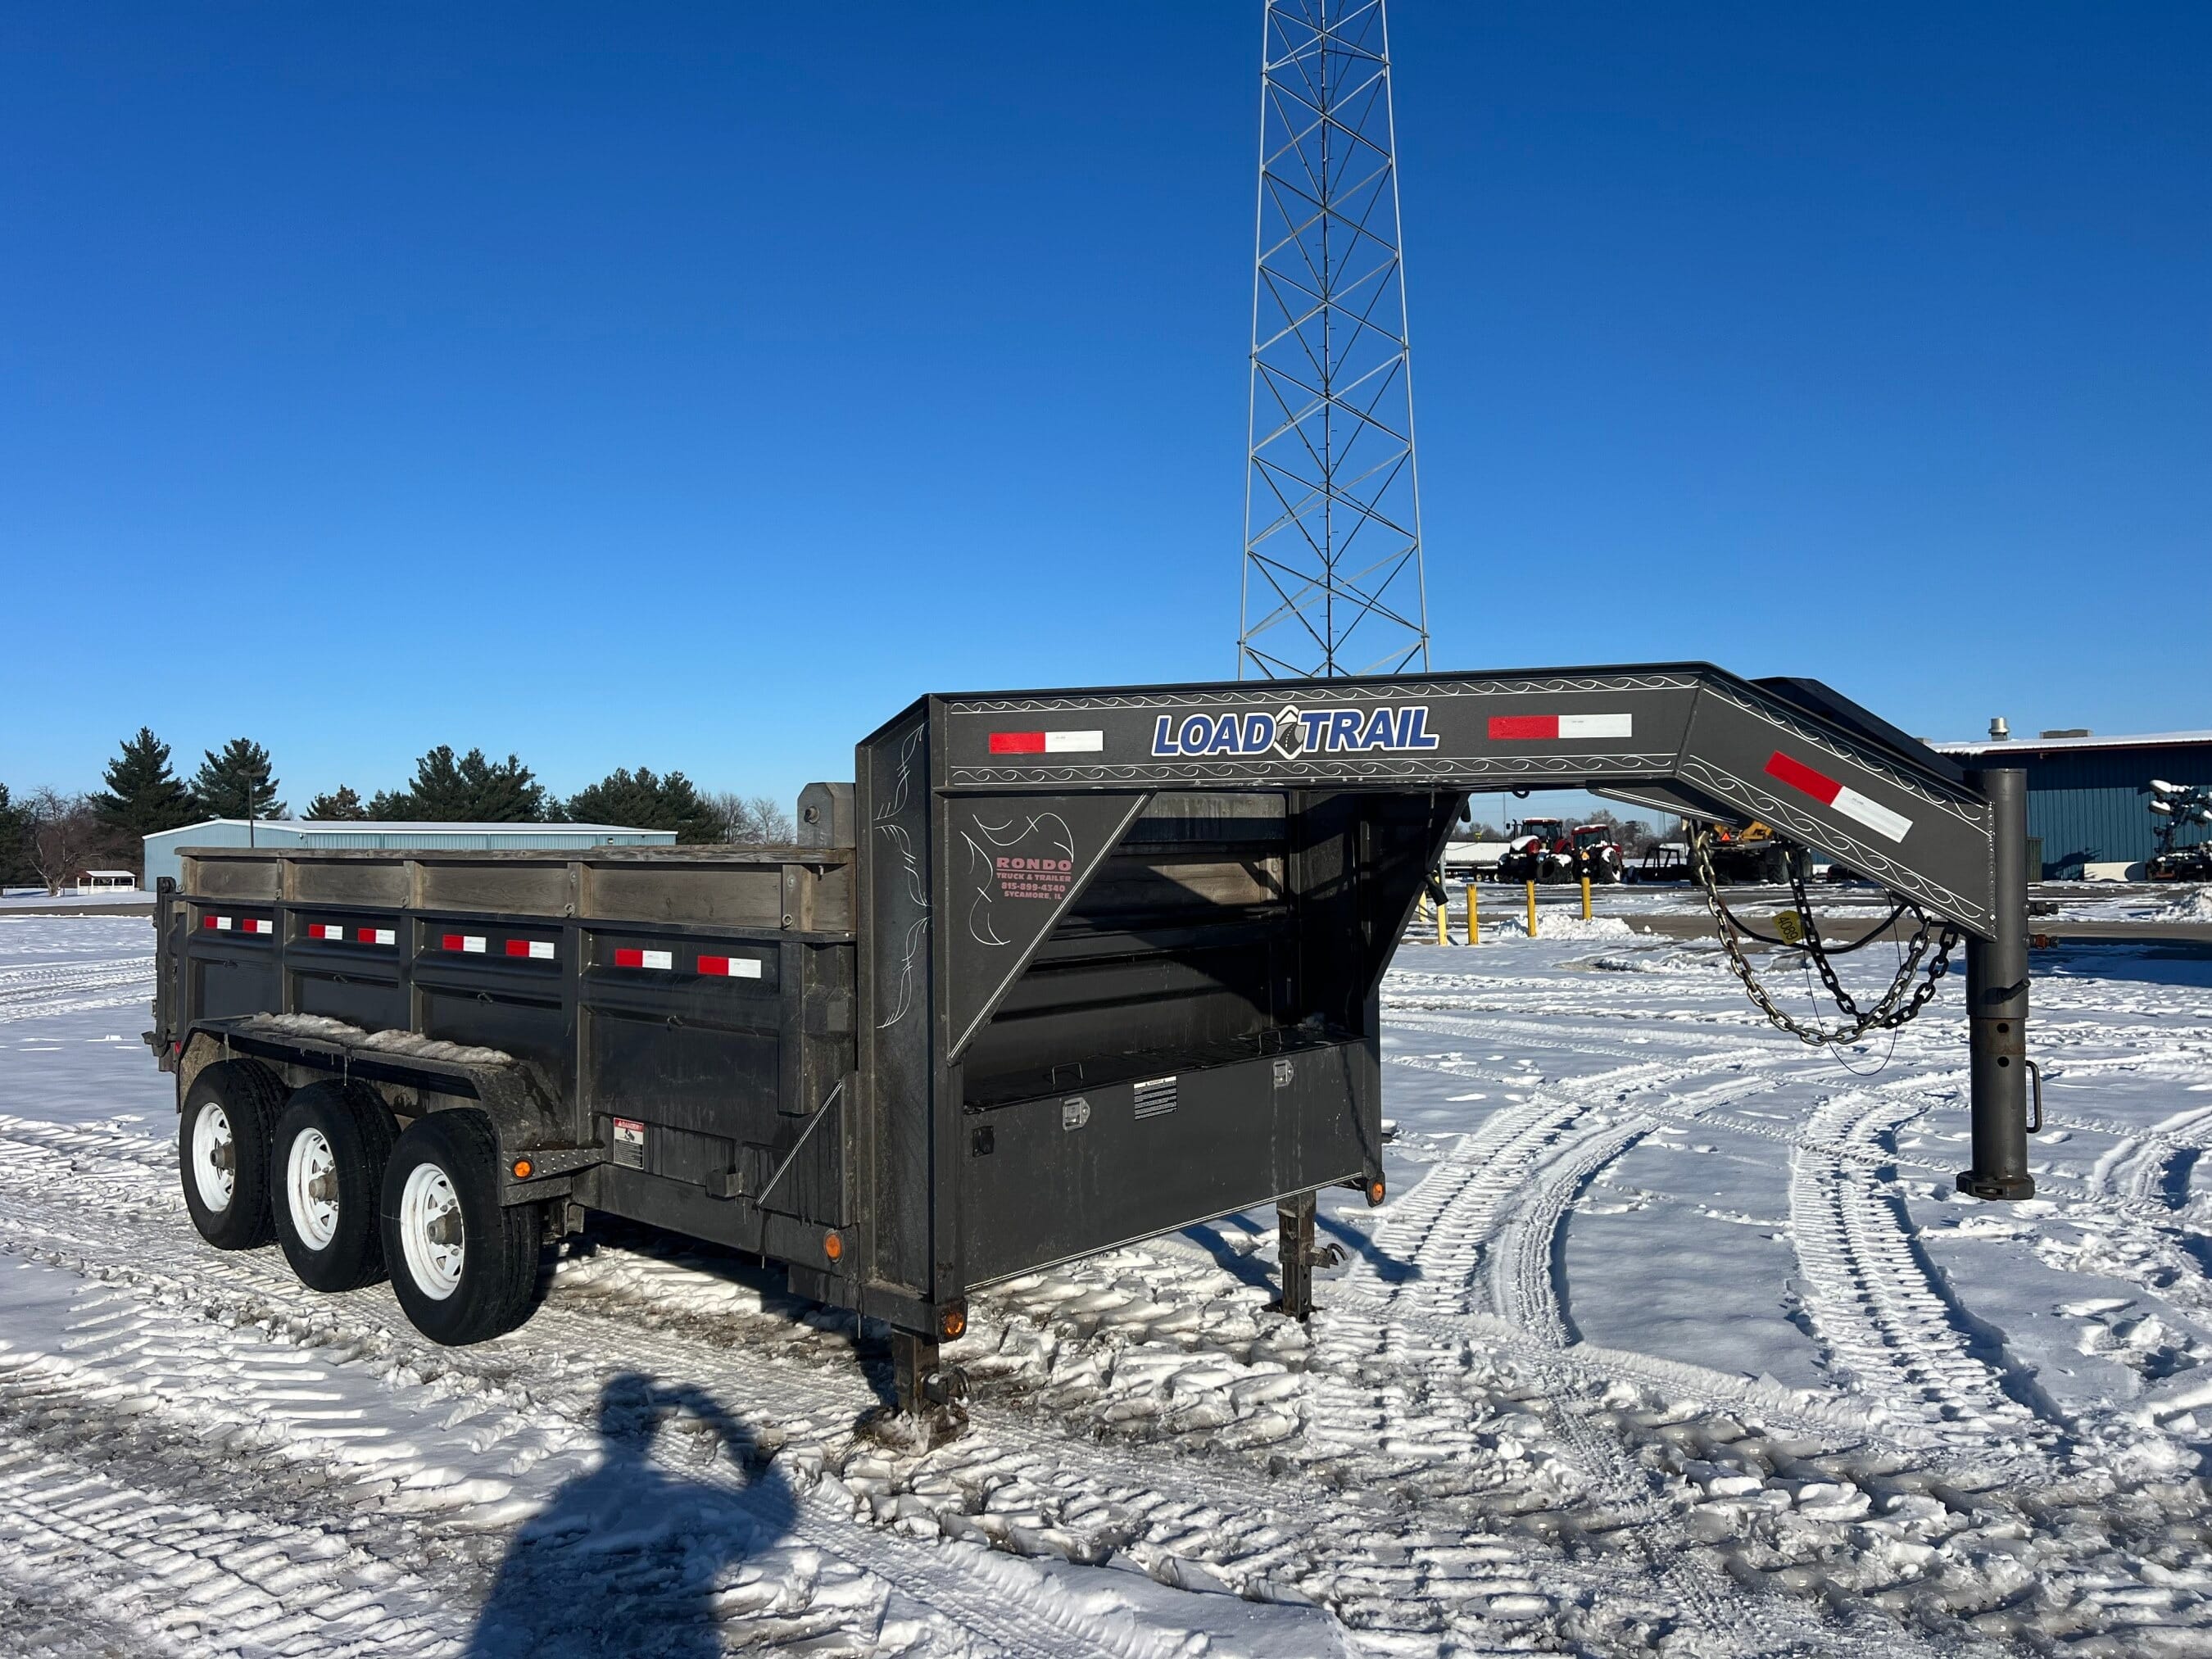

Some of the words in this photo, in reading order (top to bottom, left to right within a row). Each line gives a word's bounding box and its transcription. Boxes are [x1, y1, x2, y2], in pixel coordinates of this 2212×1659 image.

[1151, 713, 1276, 756] LOAD
[1298, 706, 1439, 752] TRAIL
[996, 857, 1072, 871] RONDO
[1035, 874, 1072, 882] TRAILER
[1001, 882, 1065, 892] 815-899-4340
[1004, 891, 1051, 900] SYCAMORE,
[1778, 917, 1798, 940] 4089
